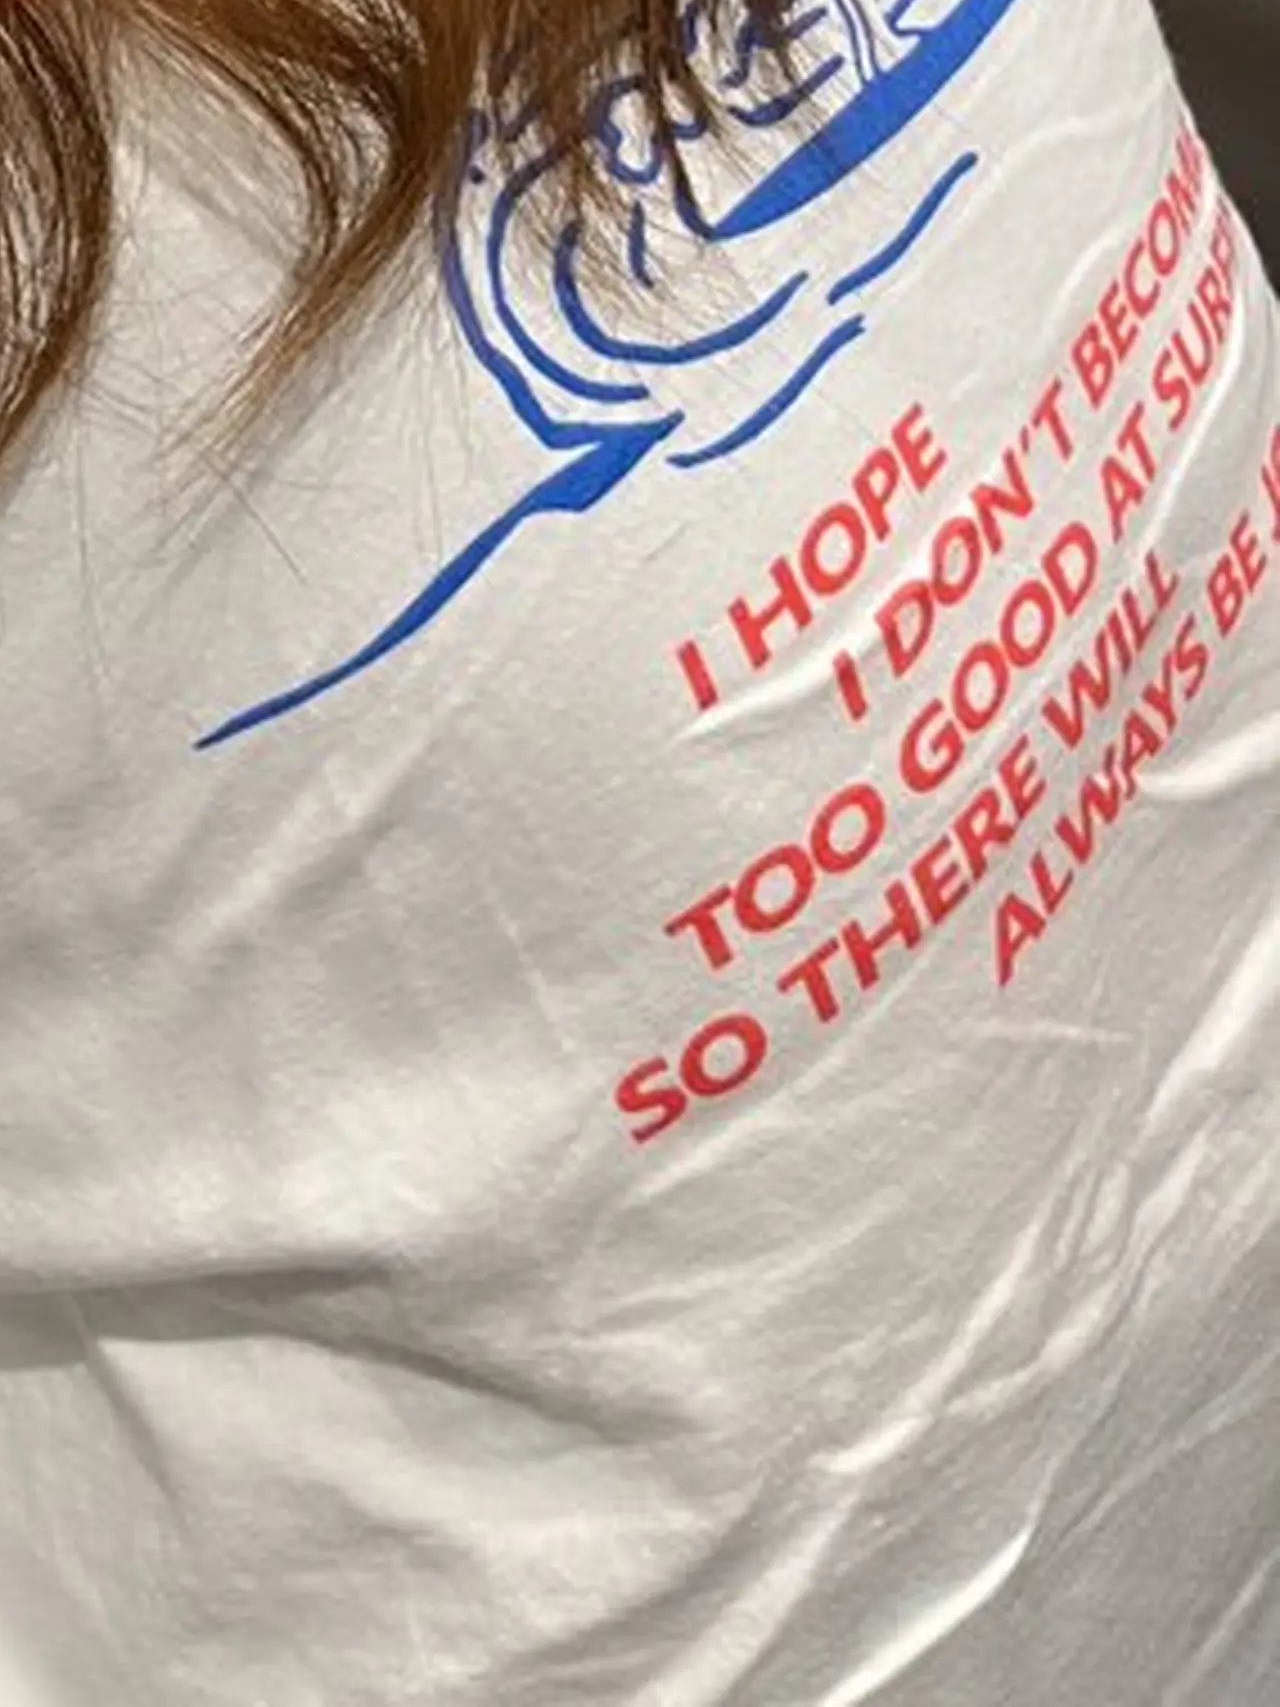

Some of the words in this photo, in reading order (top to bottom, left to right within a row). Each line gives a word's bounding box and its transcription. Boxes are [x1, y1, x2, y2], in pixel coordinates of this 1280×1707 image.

[663, 782, 886, 970] TOO
[900, 521, 1099, 794] GOOD
[1099, 401, 1158, 545] AT
[676, 640, 718, 711] I
[728, 401, 948, 670] HOPE
[833, 648, 868, 721] I
[874, 377, 1073, 678] DON'T
[1070, 130, 1202, 412] BECOM
[615, 1012, 768, 1144] SO
[776, 732, 1047, 1024] THERE
[1042, 549, 1180, 750] WILL
[996, 614, 1209, 987] ALWAYS
[1206, 510, 1269, 639] BE
